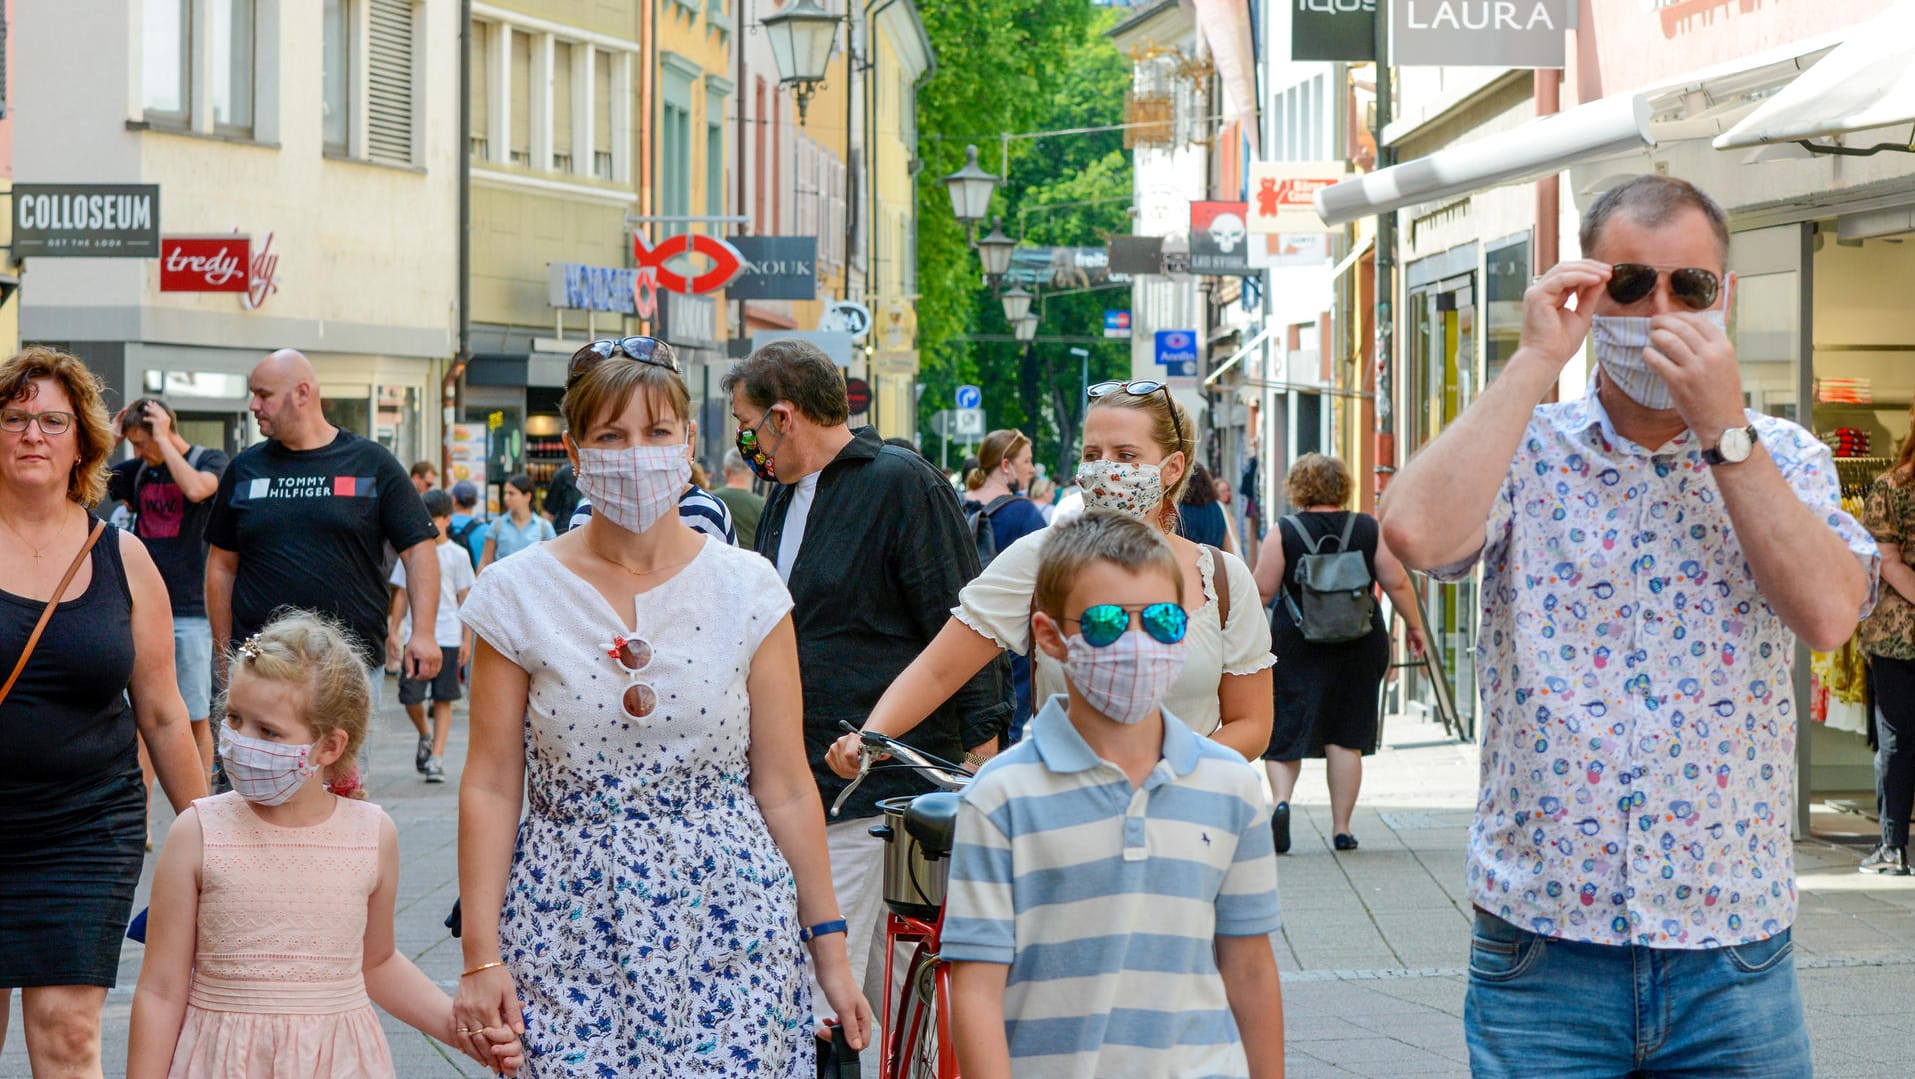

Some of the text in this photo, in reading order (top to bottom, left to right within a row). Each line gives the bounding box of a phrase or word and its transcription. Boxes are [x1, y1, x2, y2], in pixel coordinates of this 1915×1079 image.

[1407, 0, 1555, 30] LAURA
[19, 194, 150, 230] COLLOSEUM
[166, 246, 244, 285] tredy
[744, 259, 811, 277] NOUK
[269, 487, 331, 498] HILFIGER
[277, 477, 326, 487] TOMMY
